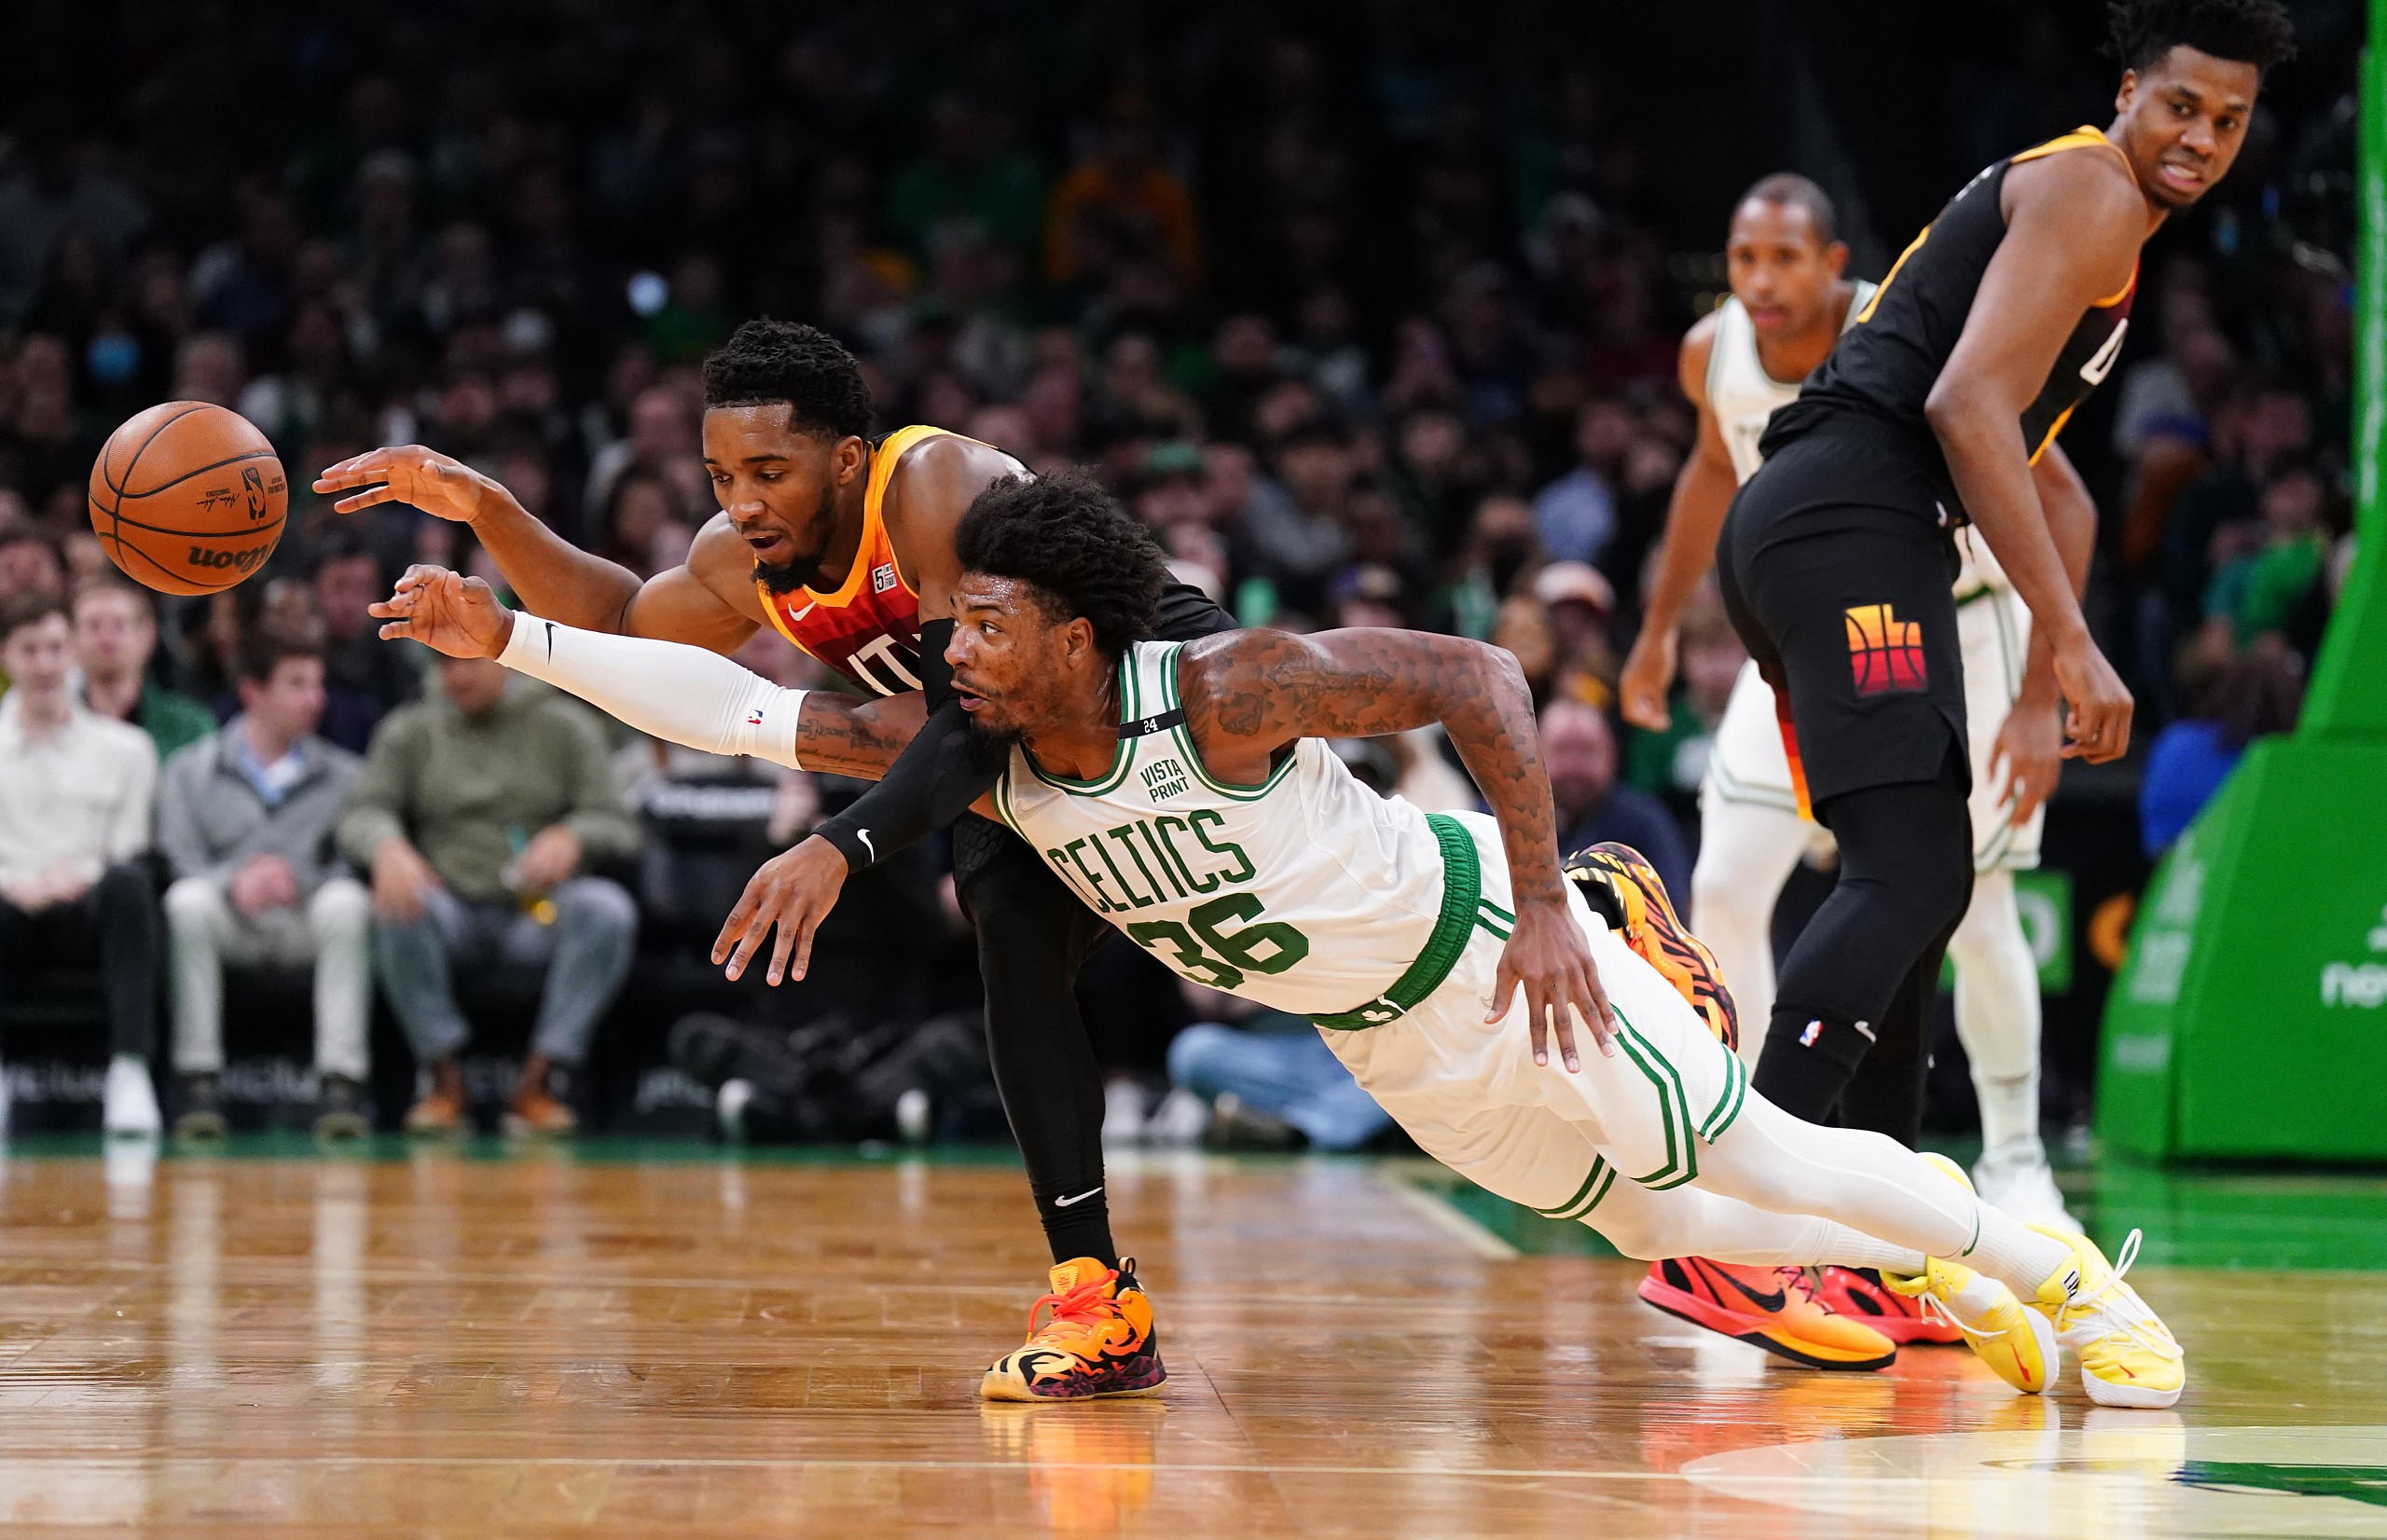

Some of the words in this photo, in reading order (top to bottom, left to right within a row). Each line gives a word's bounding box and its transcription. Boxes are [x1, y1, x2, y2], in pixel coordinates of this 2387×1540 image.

[875, 568, 884, 591] 5
[1143, 718, 1158, 734] 24
[1139, 759, 1184, 788] VISTA
[1149, 777, 1190, 803] PRINT
[1047, 809, 1257, 913] CELTICS
[1126, 892, 1309, 990] 36
